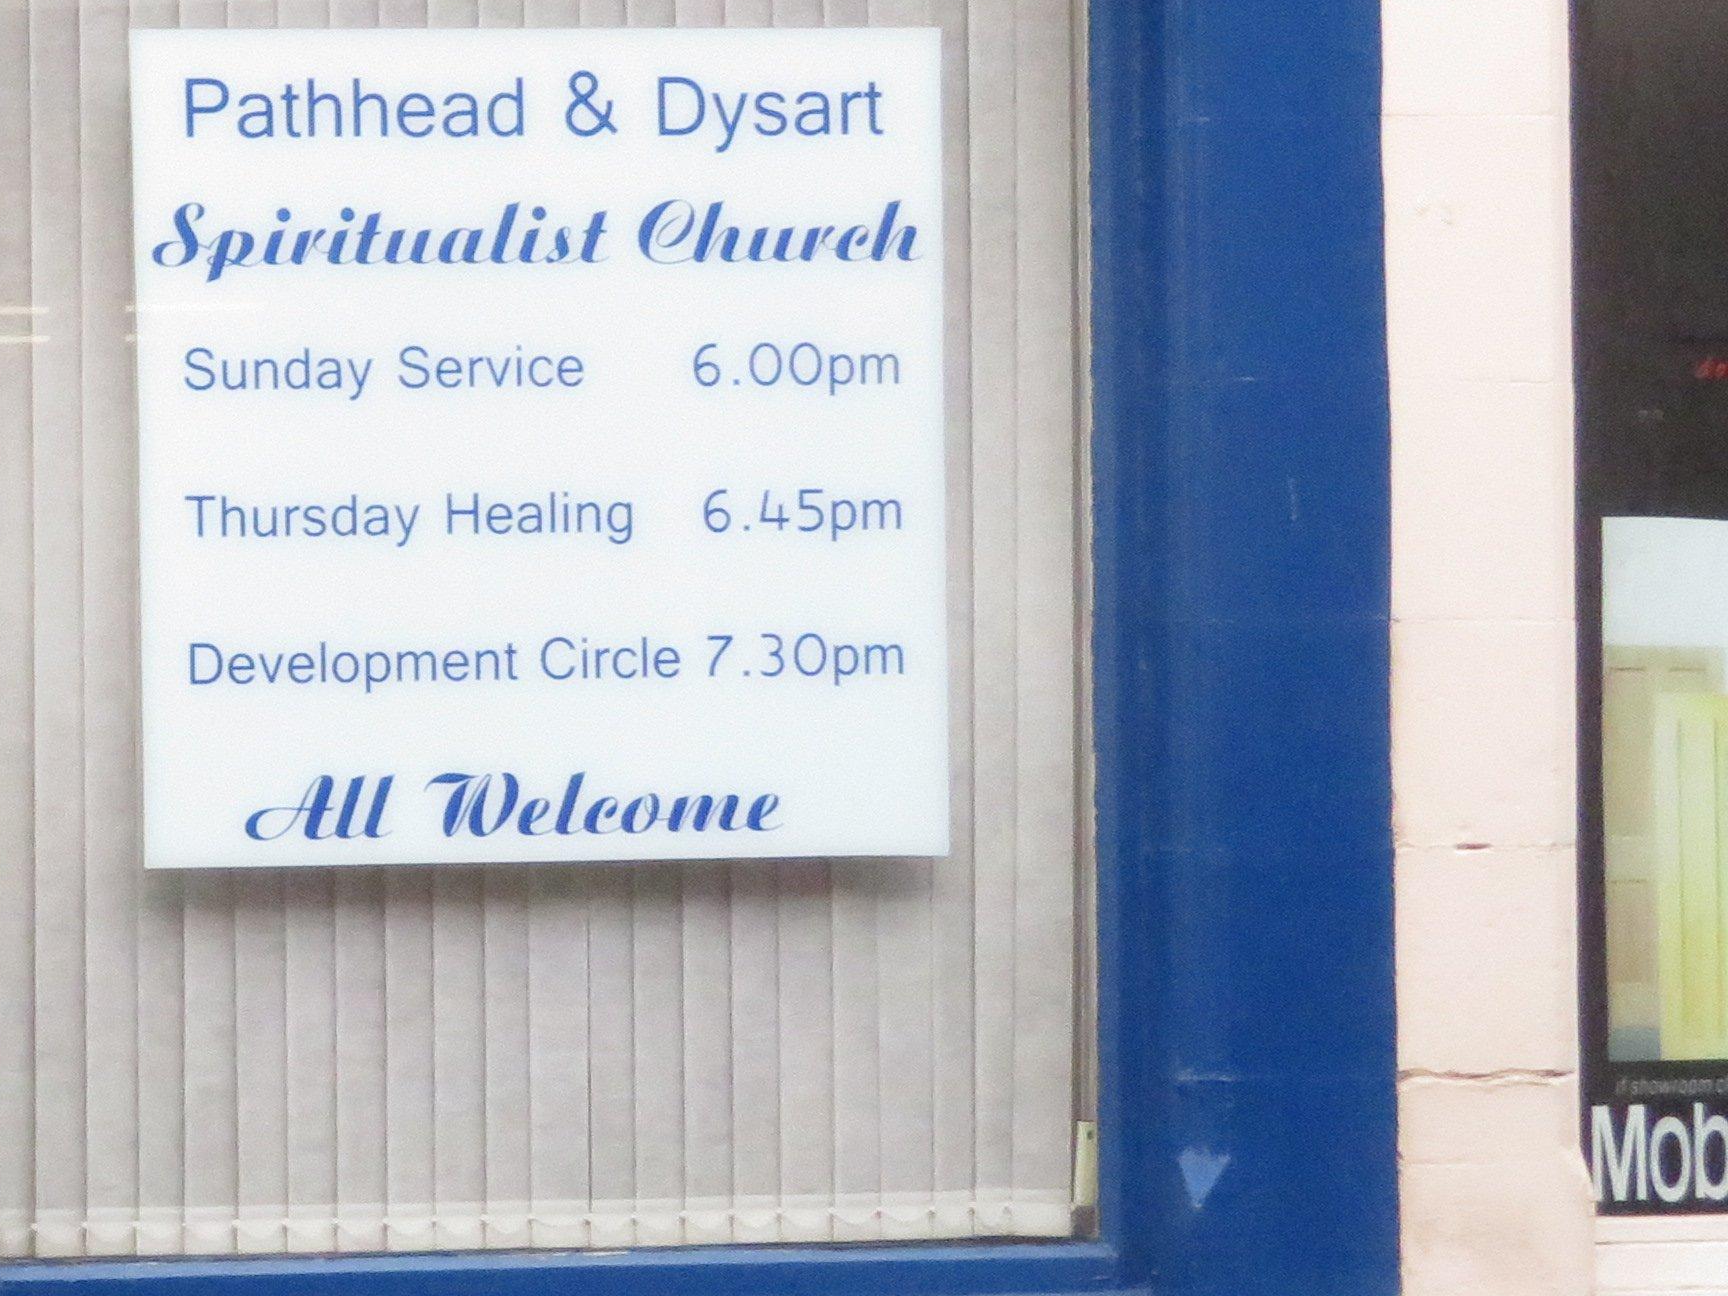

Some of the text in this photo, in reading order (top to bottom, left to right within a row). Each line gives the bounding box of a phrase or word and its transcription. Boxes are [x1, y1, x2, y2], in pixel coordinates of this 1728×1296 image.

[182, 67, 888, 156] Pathhead & Dysart
[148, 196, 925, 286] Spiritualist Church
[181, 339, 903, 404] Sunday Service 6.00pm
[183, 485, 907, 551] Thursday Healing 6.45pm
[186, 628, 908, 696] Development Circle 7.30pm
[242, 768, 788, 844] All Welcome
